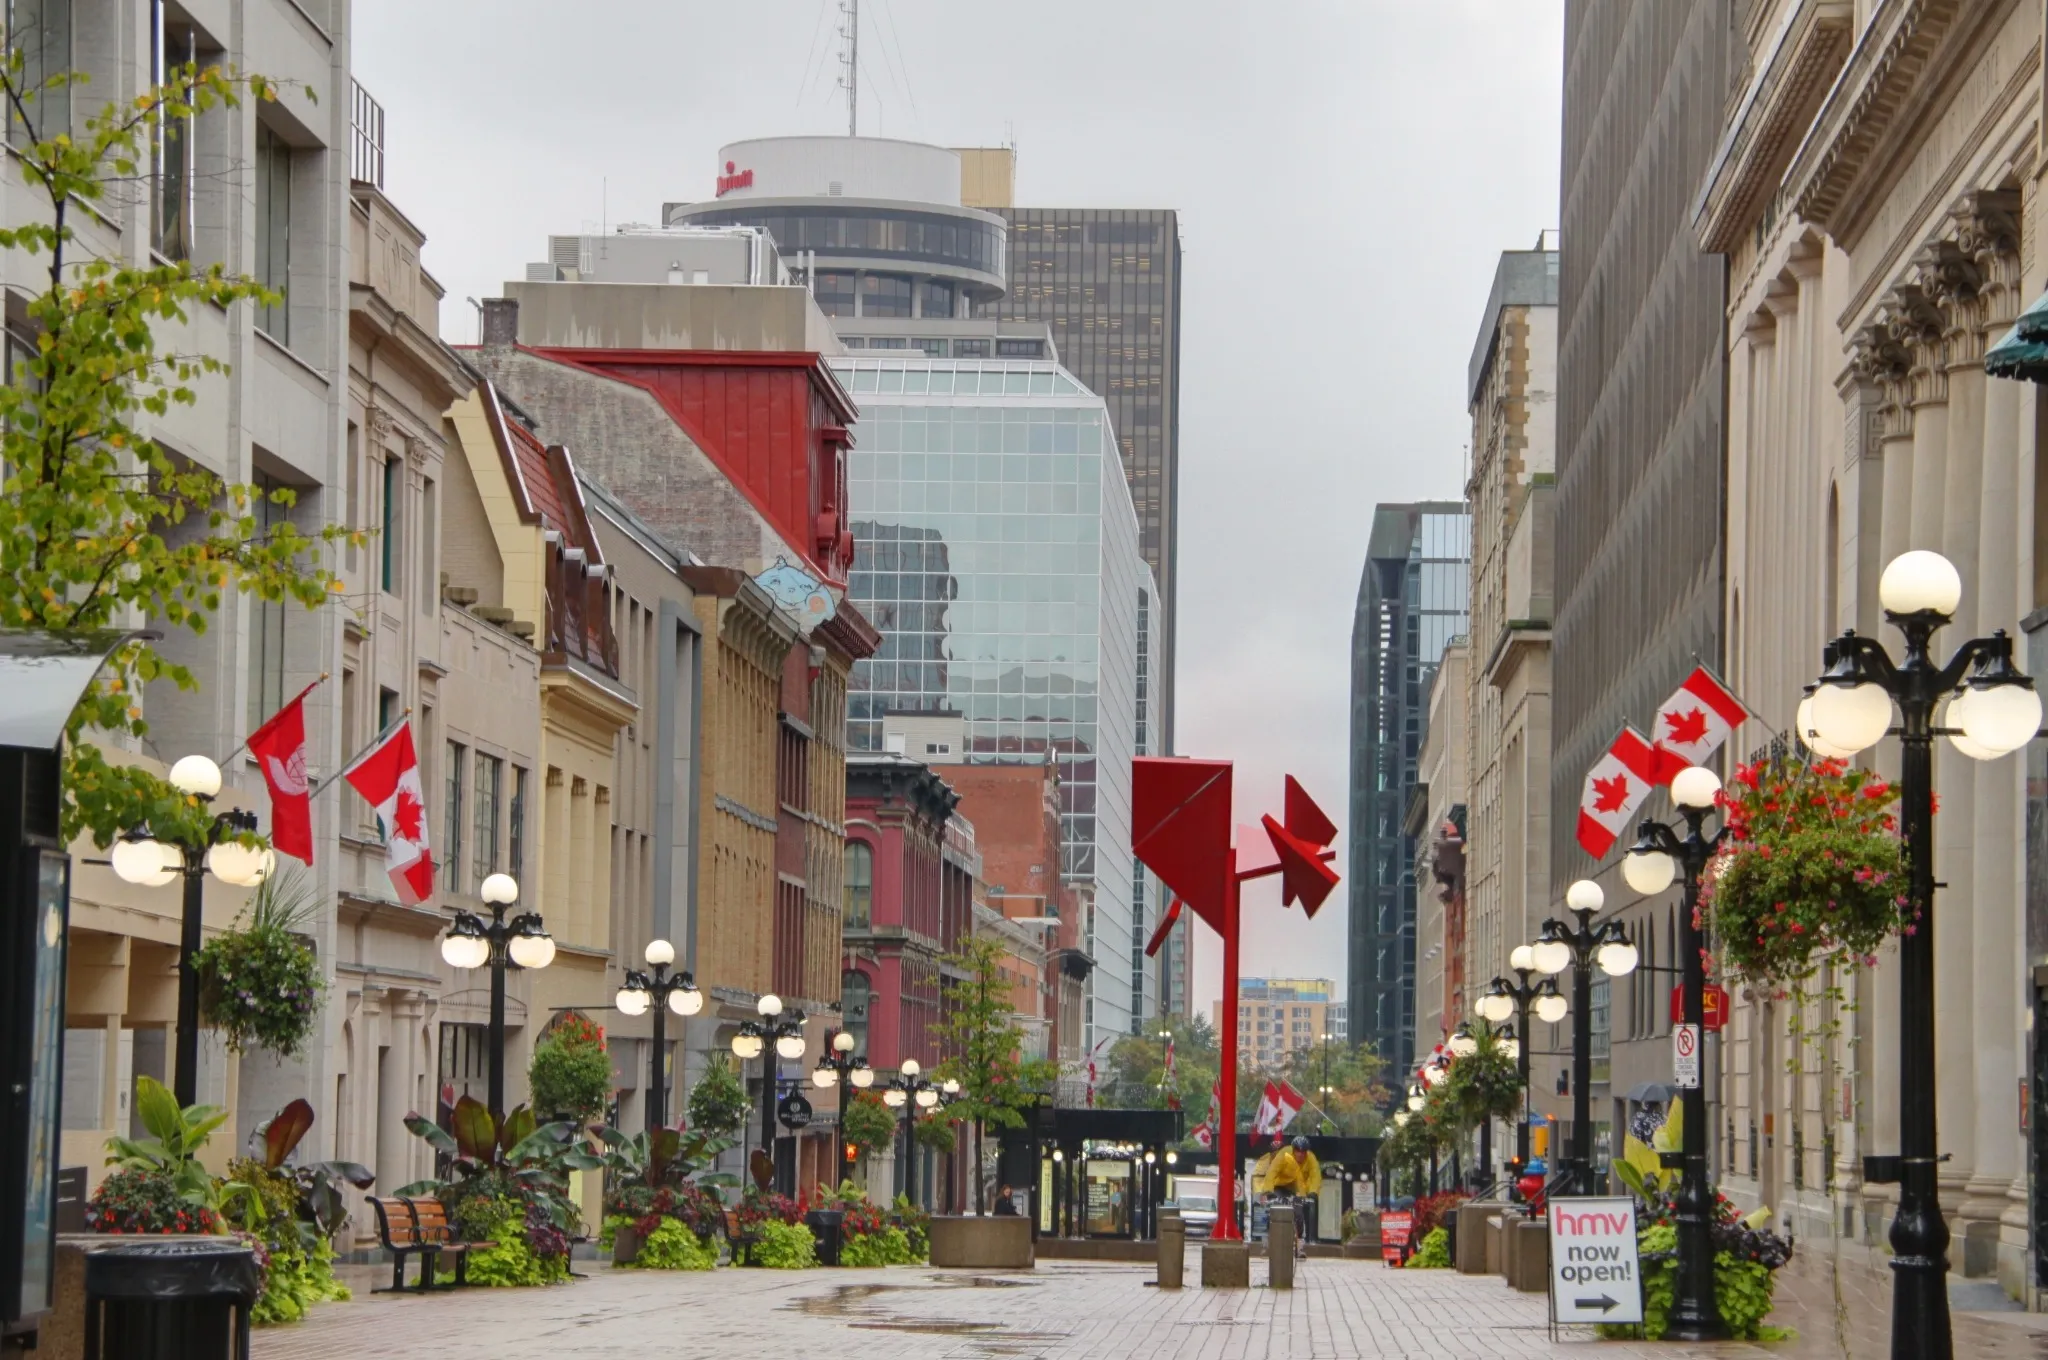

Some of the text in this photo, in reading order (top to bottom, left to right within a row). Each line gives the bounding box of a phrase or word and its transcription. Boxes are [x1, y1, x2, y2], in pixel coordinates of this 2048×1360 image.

[1556, 1206, 1628, 1236] hmv
[1568, 1245, 1620, 1262] now
[1561, 1261, 1631, 1285] open!
